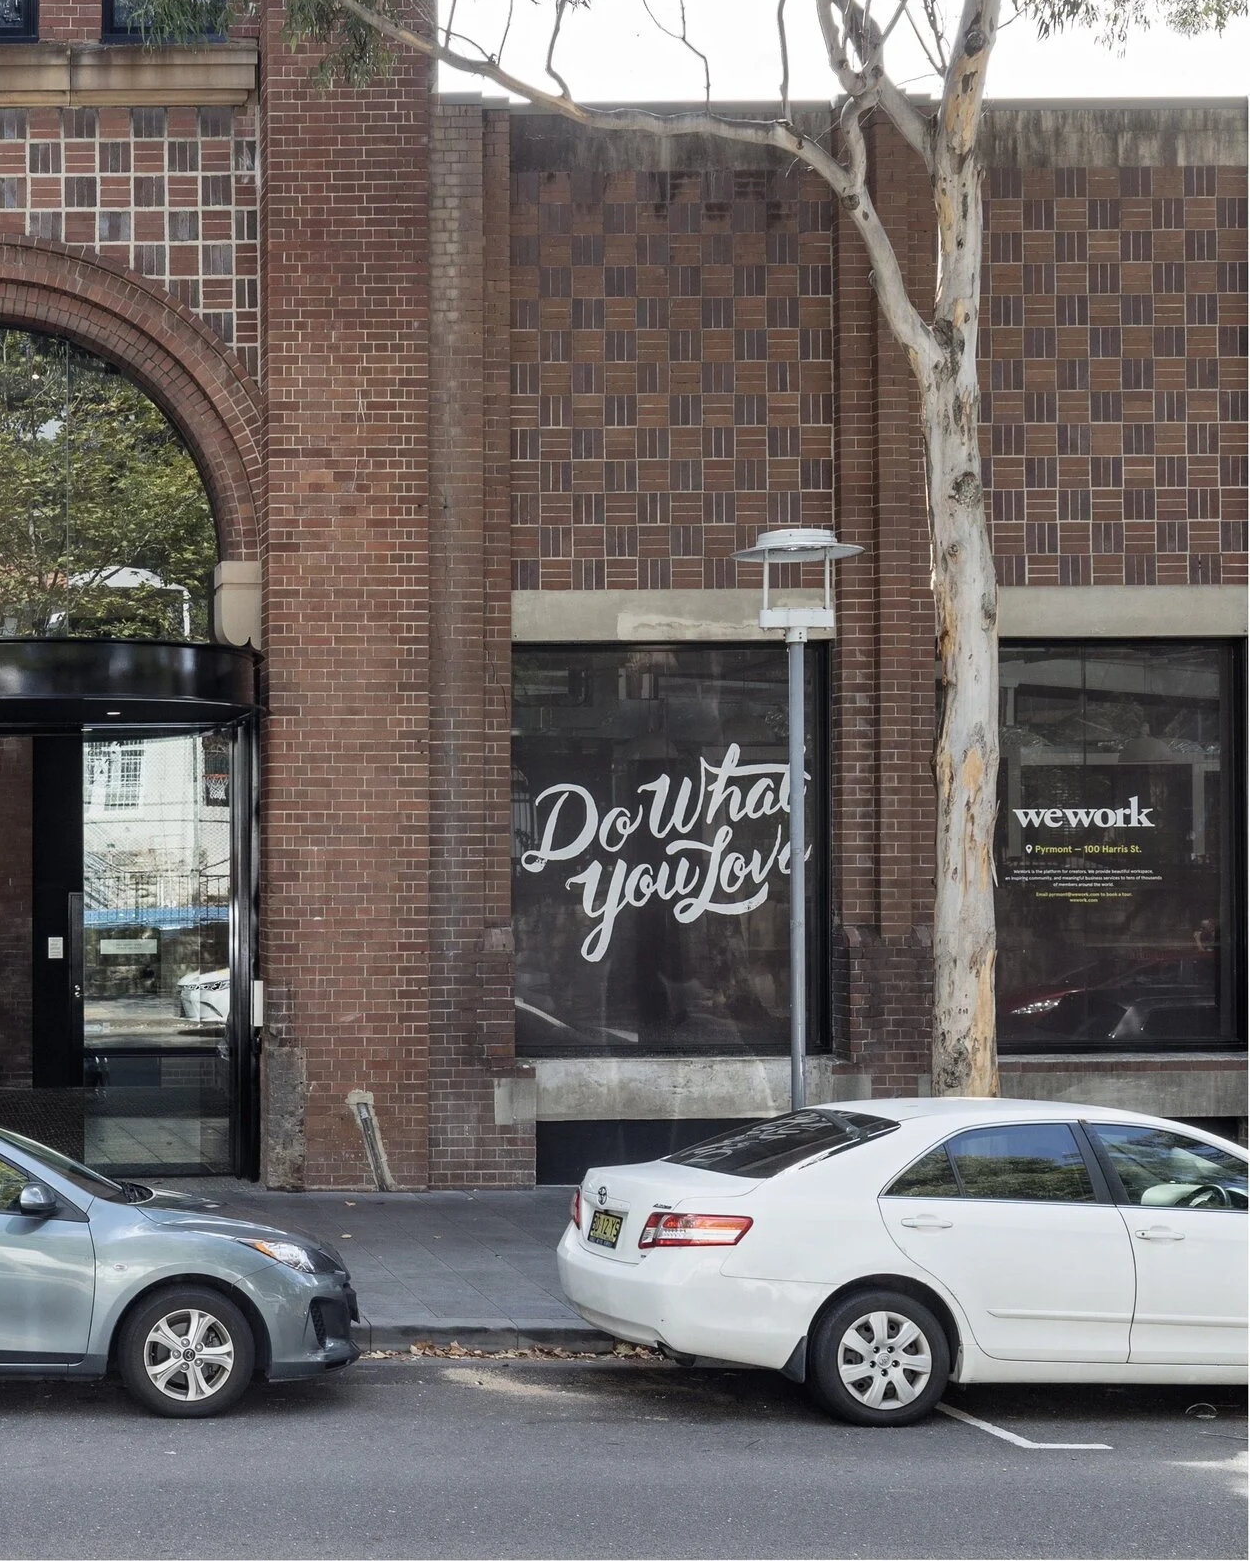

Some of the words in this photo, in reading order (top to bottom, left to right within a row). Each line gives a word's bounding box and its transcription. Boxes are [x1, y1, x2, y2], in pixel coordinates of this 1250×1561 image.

[521, 783, 643, 873] Do
[1012, 795, 1156, 828] wework
[1035, 845, 1073, 855] Pyrmont
[1084, 845, 1100, 853] 100
[1102, 845, 1129, 853] Harris
[1130, 845, 1142, 853] St.
[565, 858, 700, 963] You
